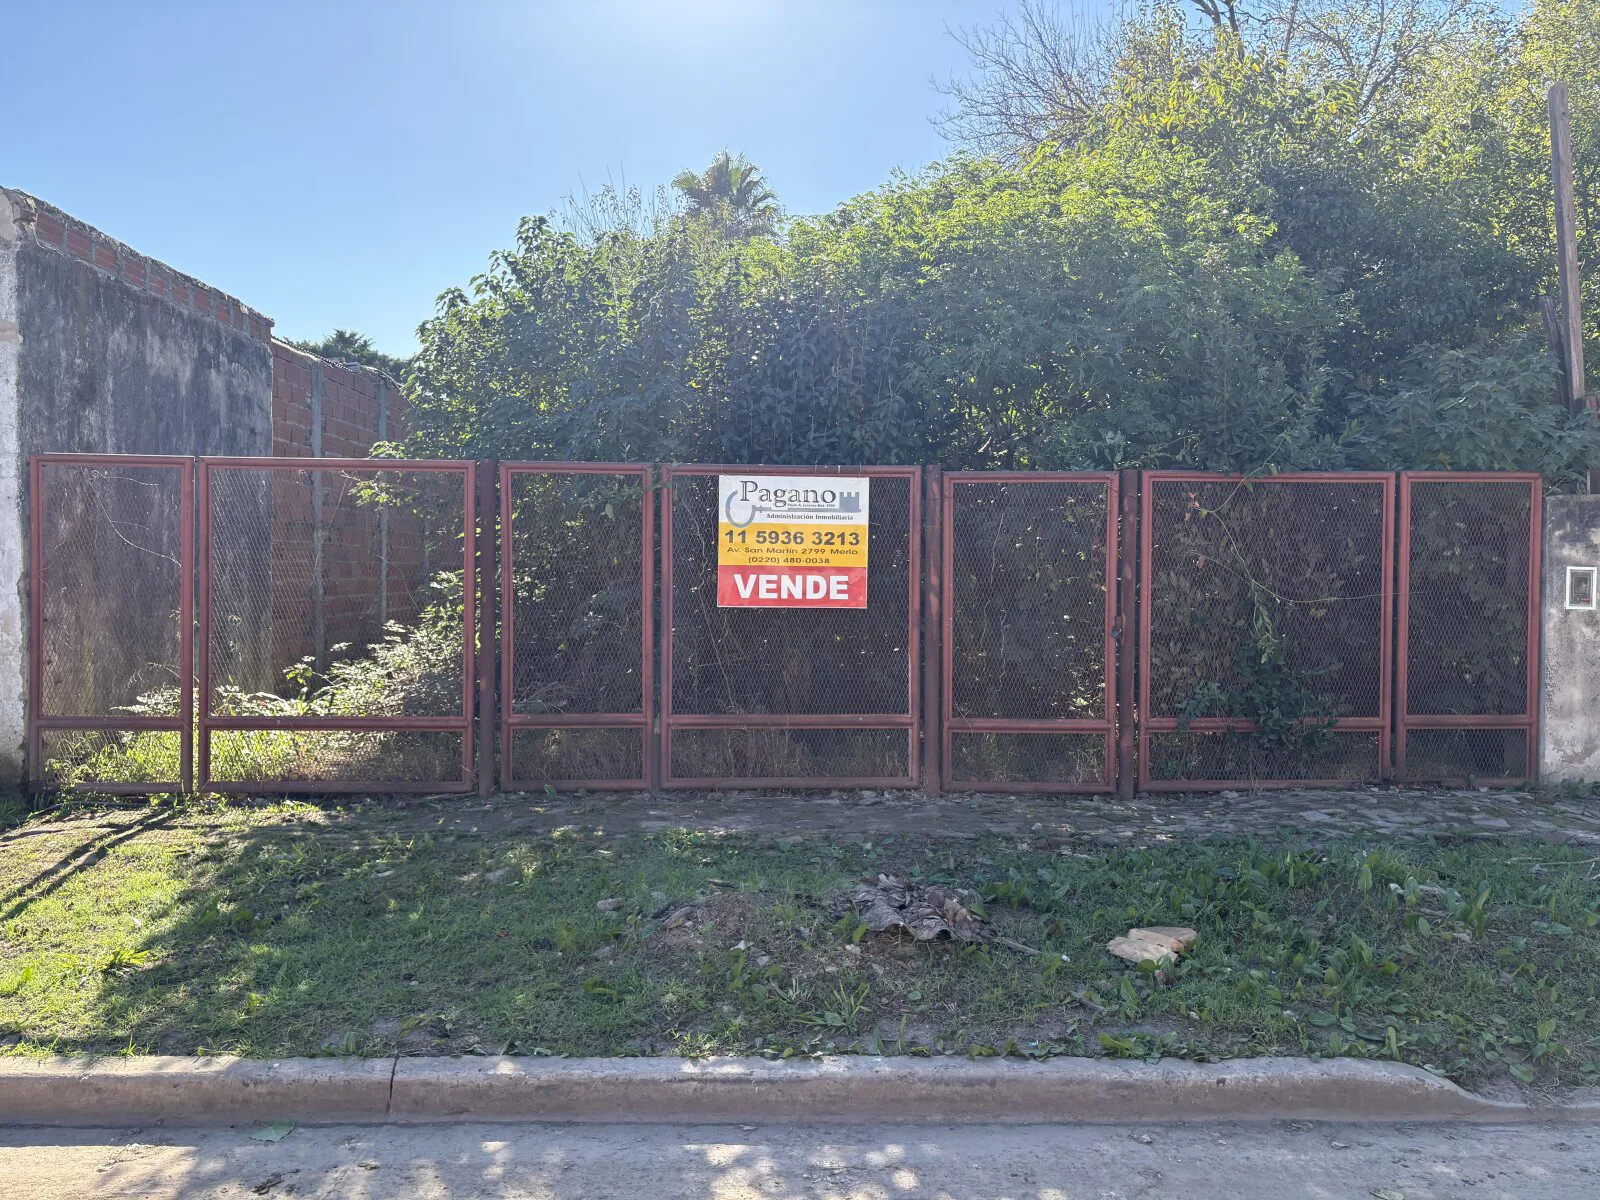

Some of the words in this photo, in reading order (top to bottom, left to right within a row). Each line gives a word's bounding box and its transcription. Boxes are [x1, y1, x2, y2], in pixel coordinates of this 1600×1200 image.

[740, 480, 836, 507] Pagano
[725, 530, 746, 543] 11
[755, 531, 805, 545] 5936
[811, 532, 860, 546] 3213
[748, 556, 780, 564] (0220)
[733, 573, 849, 600] VENDE
